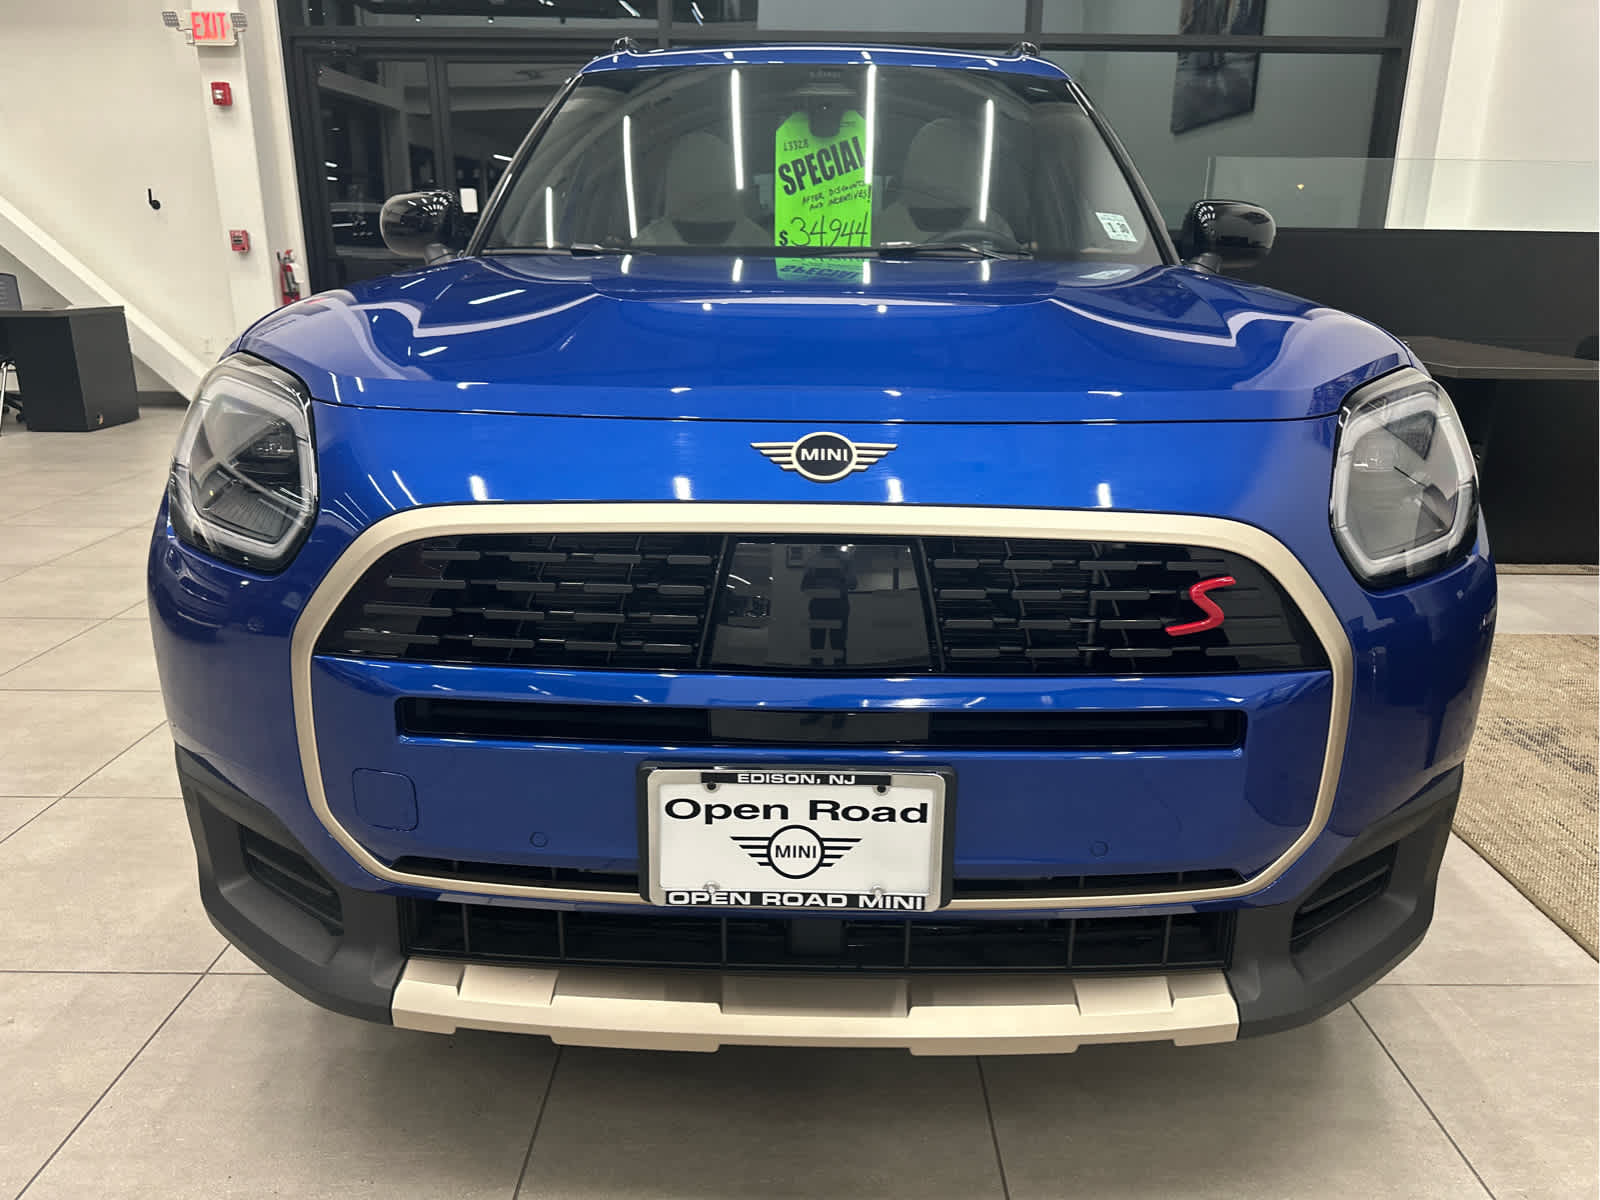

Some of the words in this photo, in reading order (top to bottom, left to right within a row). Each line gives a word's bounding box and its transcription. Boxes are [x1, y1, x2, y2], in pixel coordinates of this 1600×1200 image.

[191, 11, 226, 40] EXIT
[800, 448, 849, 462] MINI
[1164, 576, 1236, 637] S
[737, 773, 821, 785] EDISON,
[829, 774, 856, 785] NJ
[664, 798, 789, 825] Open
[808, 799, 929, 823] Road
[775, 845, 817, 859] MINI
[668, 891, 751, 906] OPEN
[761, 892, 848, 908] ROAD
[858, 893, 924, 910] MINI
